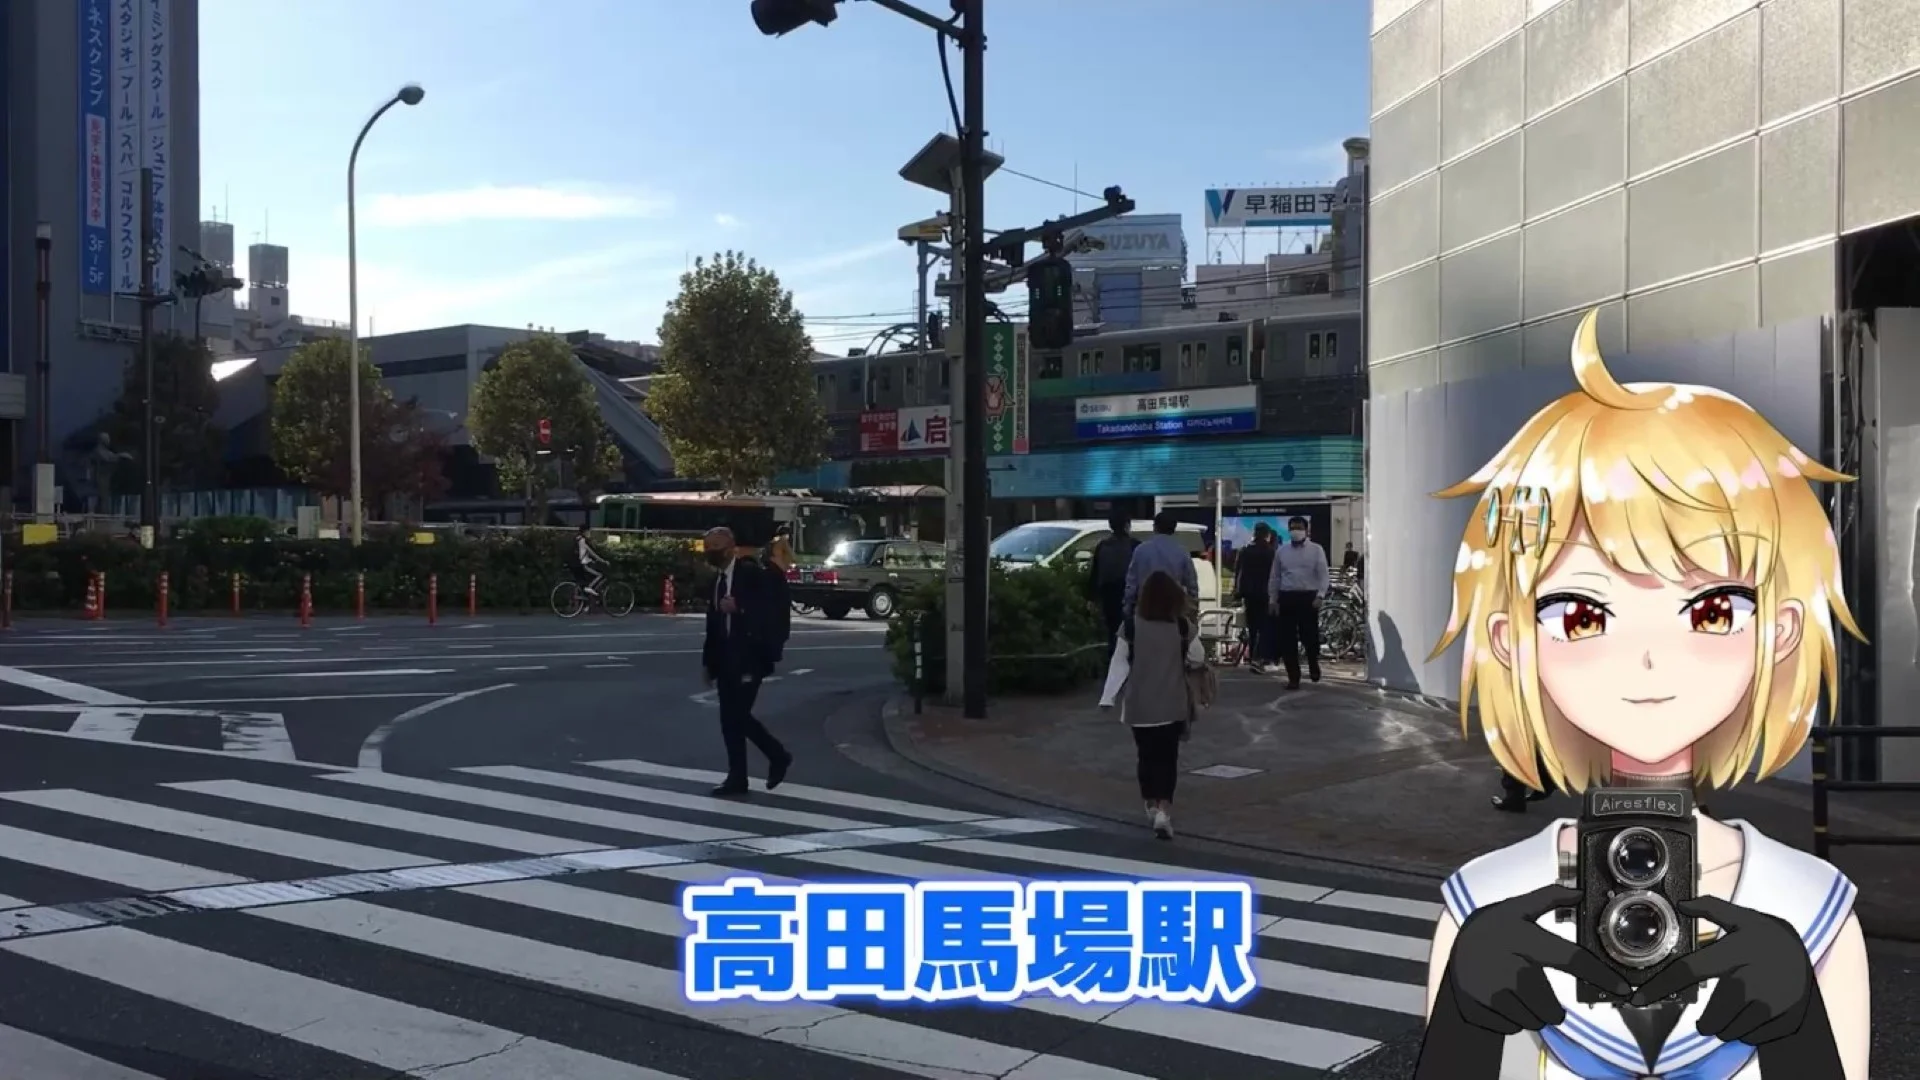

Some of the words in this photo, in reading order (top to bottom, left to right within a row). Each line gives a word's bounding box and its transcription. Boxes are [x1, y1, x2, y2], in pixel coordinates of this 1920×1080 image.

[87, 0, 104, 107] ネスクラブ
[1245, 193, 1350, 214] 早稲田予
[1137, 394, 1190, 412] 高田馬場駅
[1096, 422, 1153, 434] Takadanobaba
[1155, 420, 1184, 431] Station
